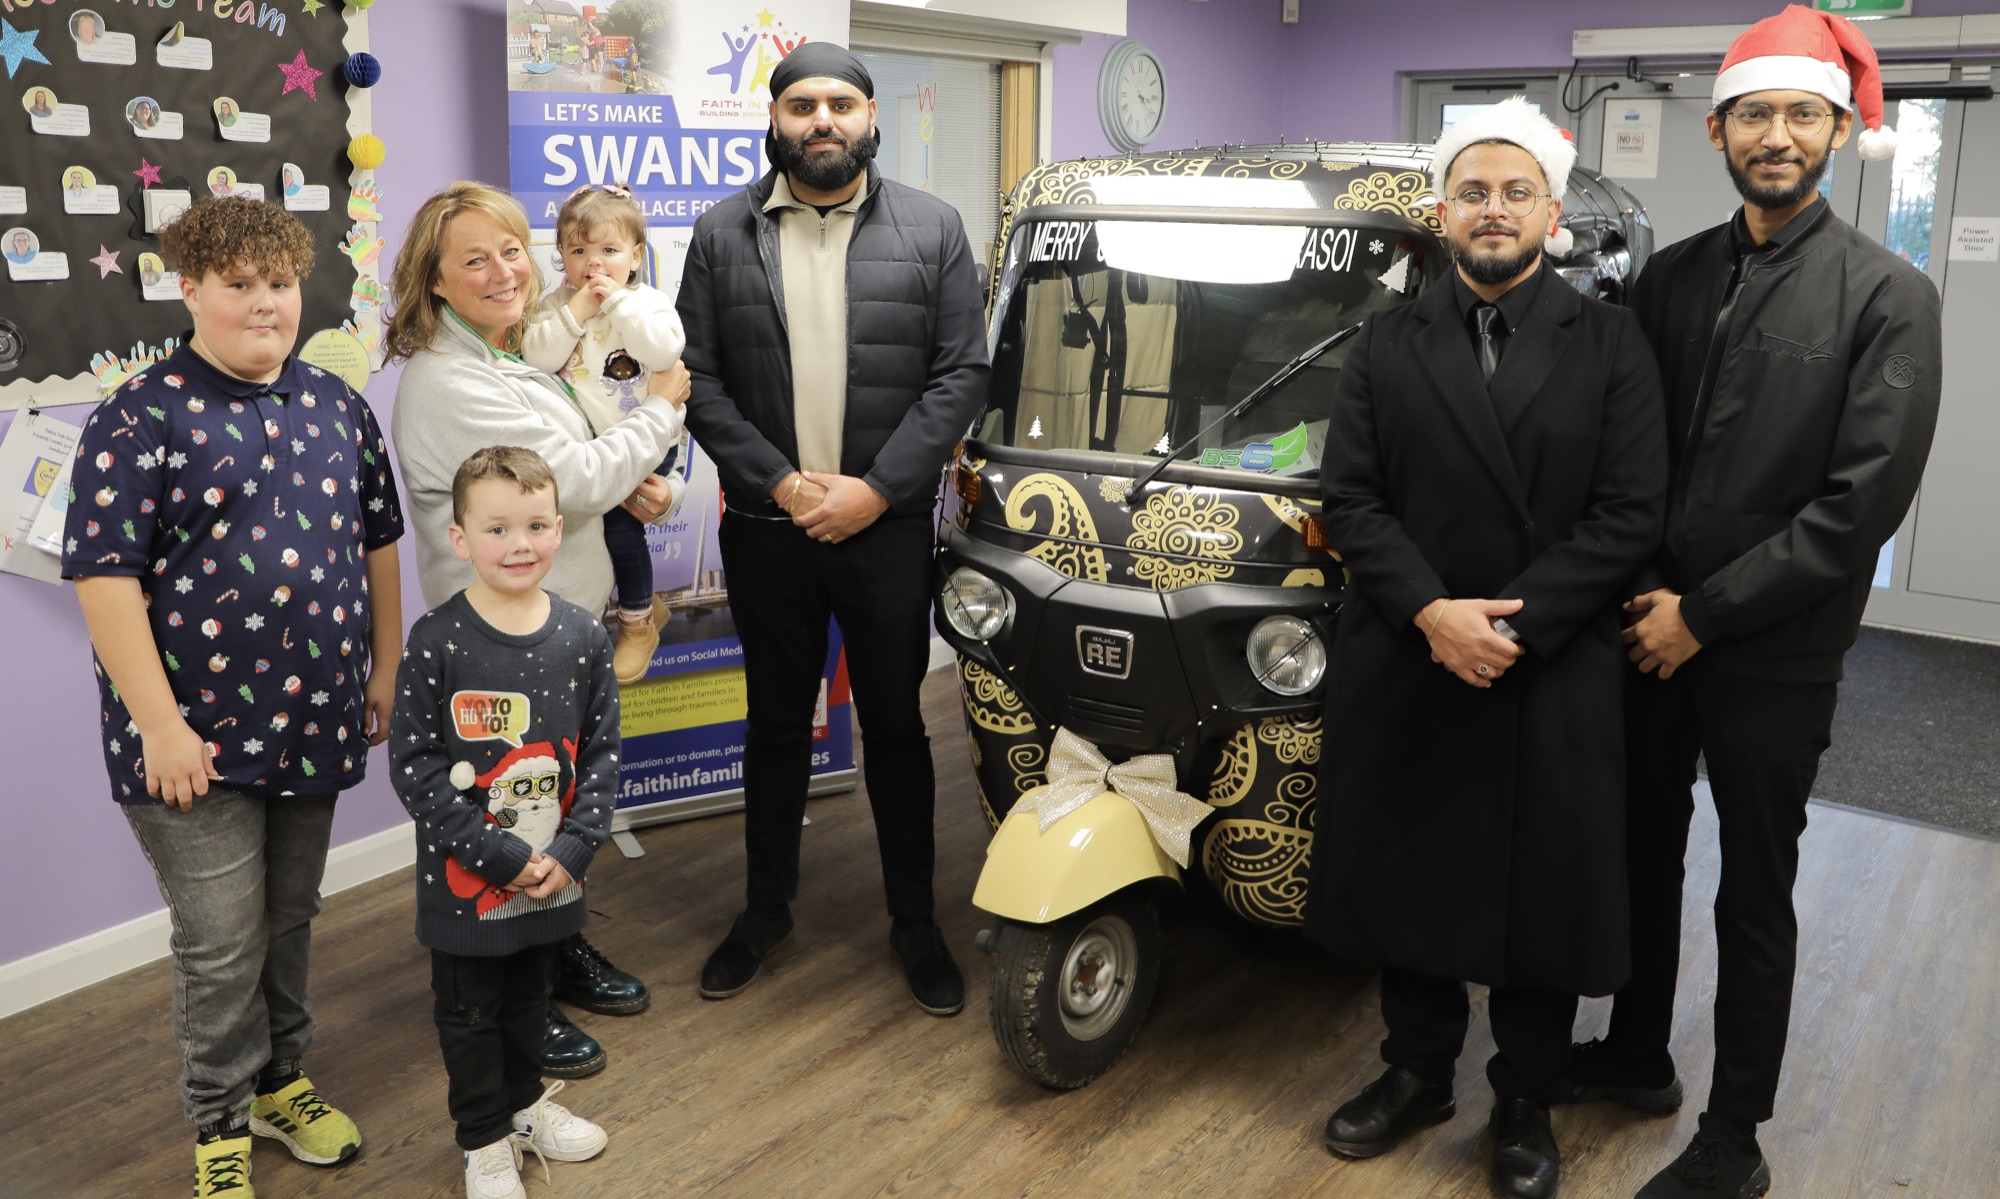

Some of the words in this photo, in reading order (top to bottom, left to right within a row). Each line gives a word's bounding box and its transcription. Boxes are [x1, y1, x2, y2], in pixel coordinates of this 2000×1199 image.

[701, 100, 742, 109] FAITH
[748, 101, 761, 109] IN
[604, 104, 663, 123] MAKE
[1619, 135, 1631, 143] NO
[544, 201, 560, 217] A
[673, 241, 689, 249] The
[1028, 221, 1094, 262] MERRY
[1296, 227, 1359, 273] ASOI
[1199, 442, 1274, 471] BS6
[1092, 636, 1116, 645] BAJAJ
[664, 656, 676, 665] us
[677, 654, 690, 663] on
[691, 649, 718, 660] Social
[1086, 642, 1122, 669] RE
[633, 700, 645, 708] for
[646, 695, 679, 707] children
[680, 692, 696, 702] and
[697, 688, 727, 700] families
[728, 686, 736, 694] in
[638, 688, 650, 698] for
[651, 685, 671, 696] Faith
[672, 684, 681, 694] in
[681, 679, 714, 691] Families
[631, 708, 654, 719] living
[655, 702, 688, 716] through
[720, 696, 740, 705] crisis
[665, 756, 676, 764] or
[677, 753, 688, 762] to
[688, 749, 723, 760] donate,
